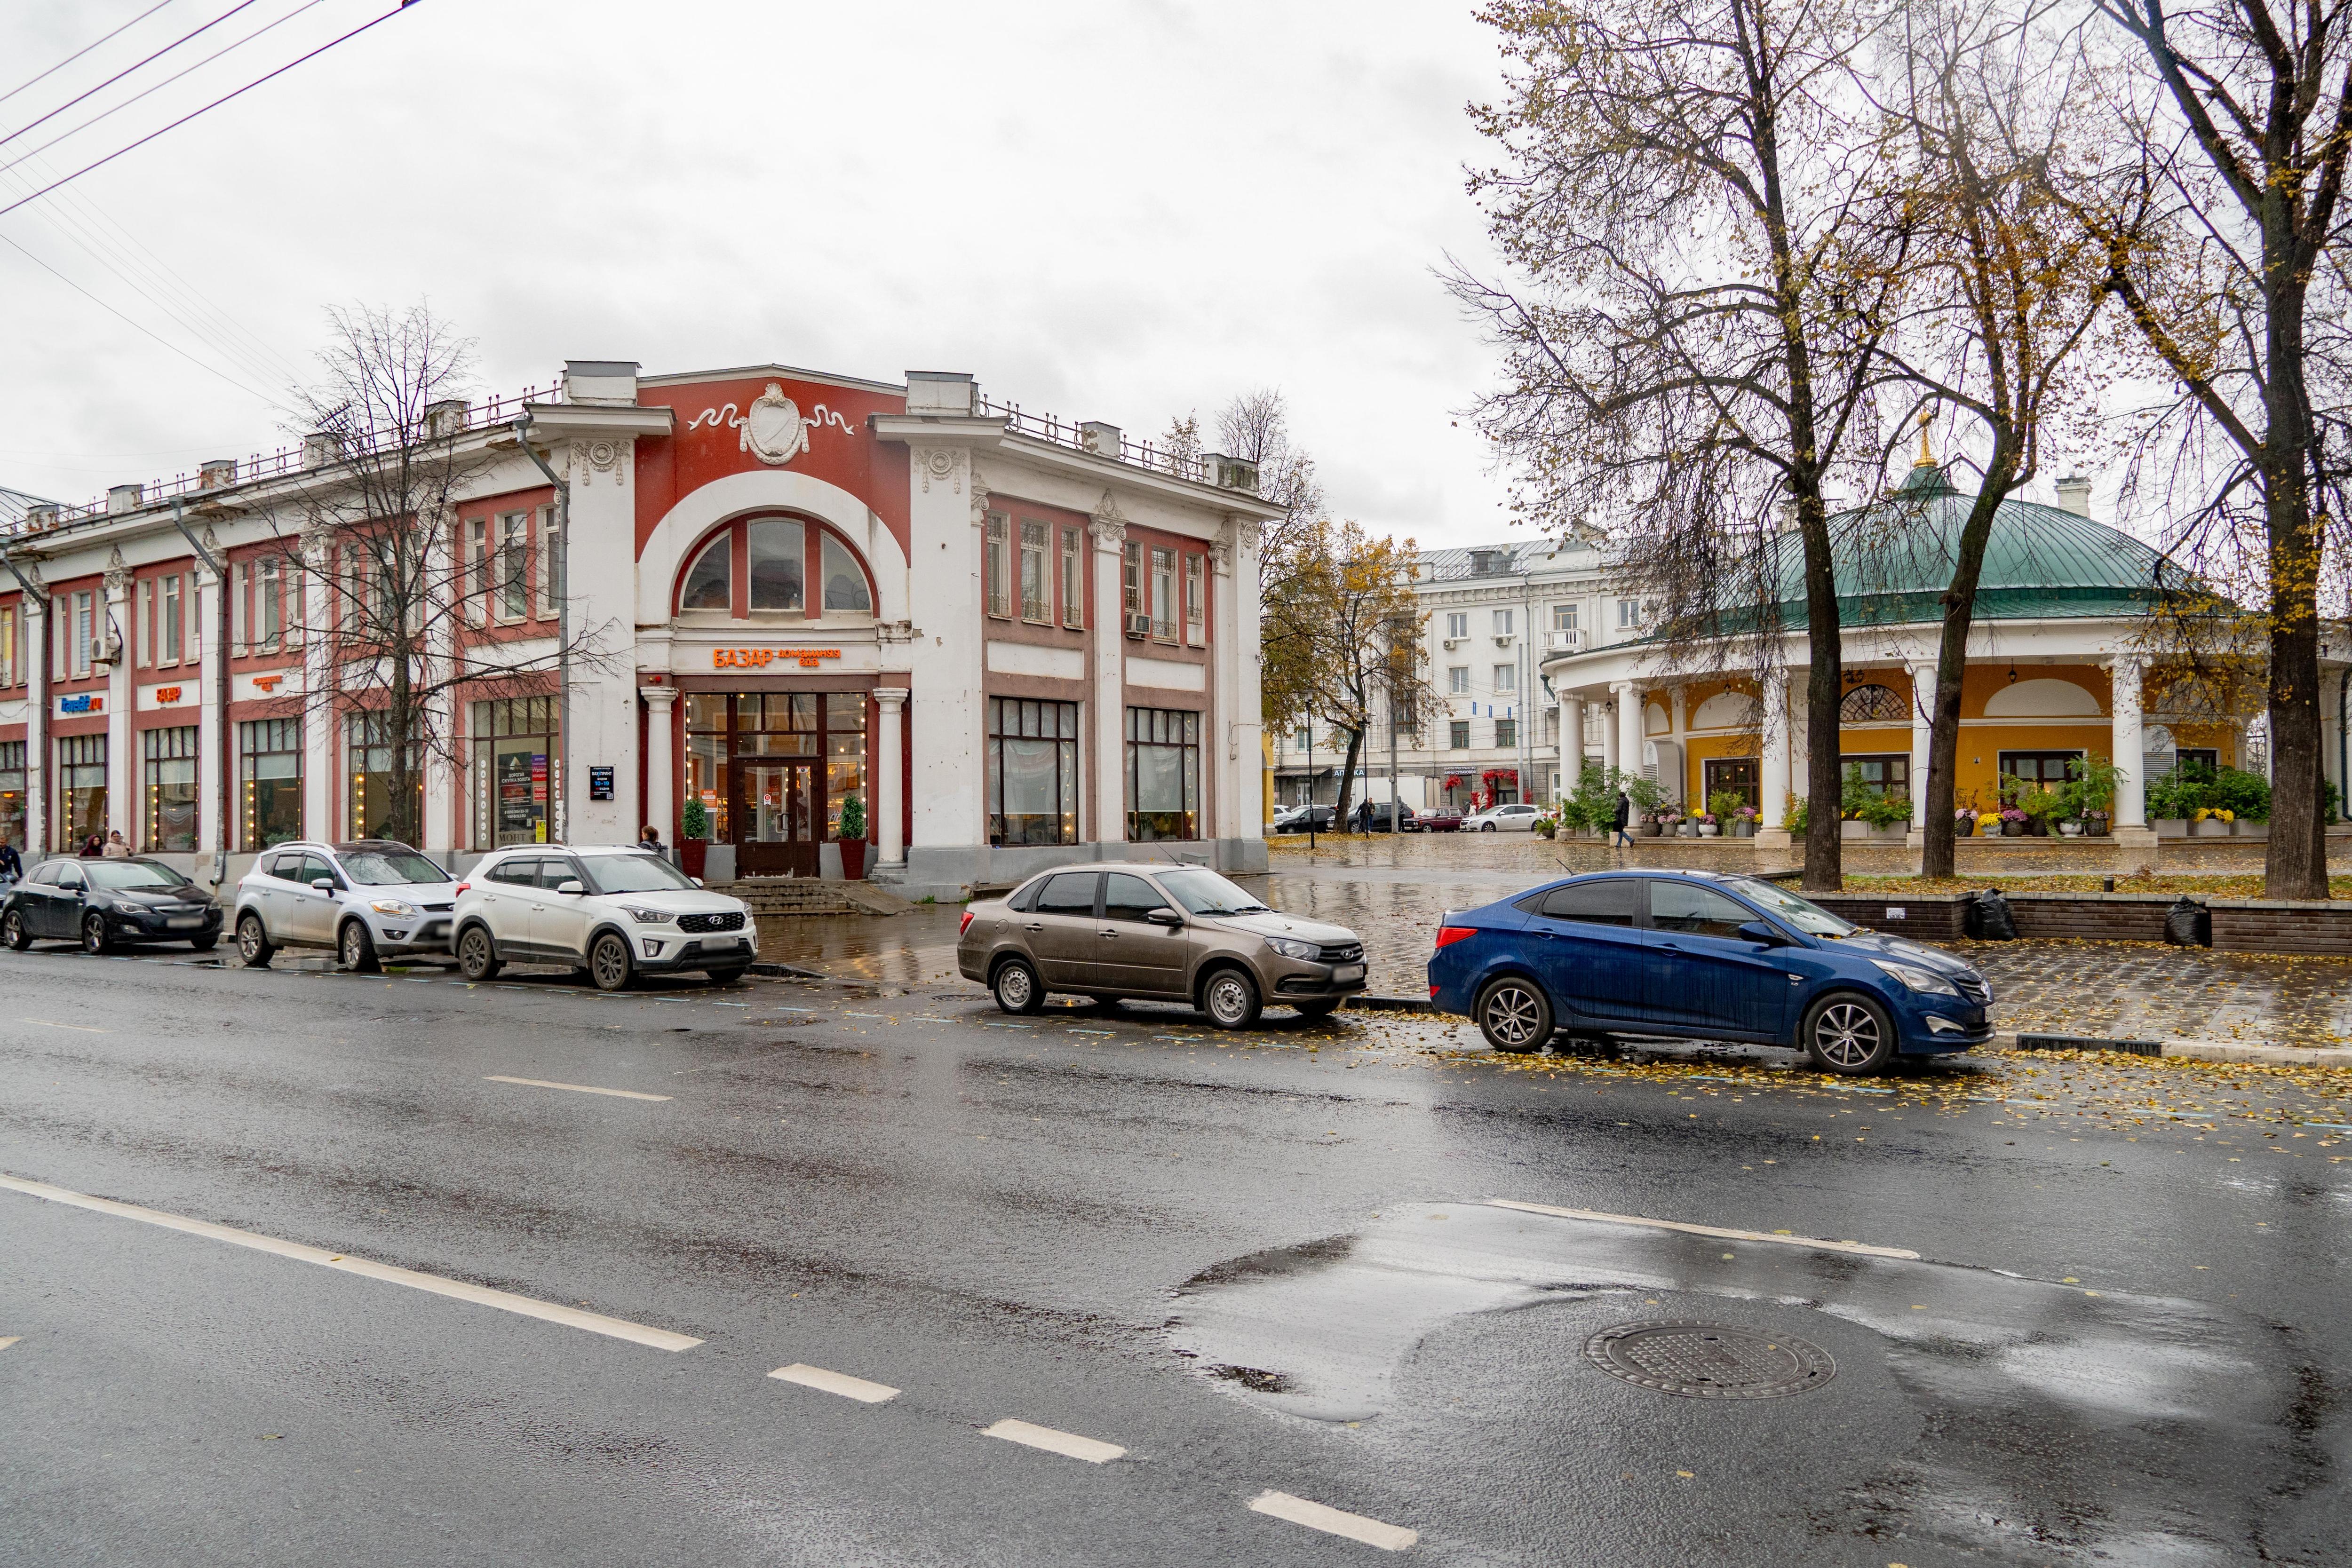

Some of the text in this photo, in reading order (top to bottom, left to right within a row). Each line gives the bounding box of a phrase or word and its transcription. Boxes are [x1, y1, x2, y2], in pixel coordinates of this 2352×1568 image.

[714, 649, 841, 667] БАЗАР домашняя
[799, 657, 820, 667] еда
[157, 687, 182, 702] БАЗАР
